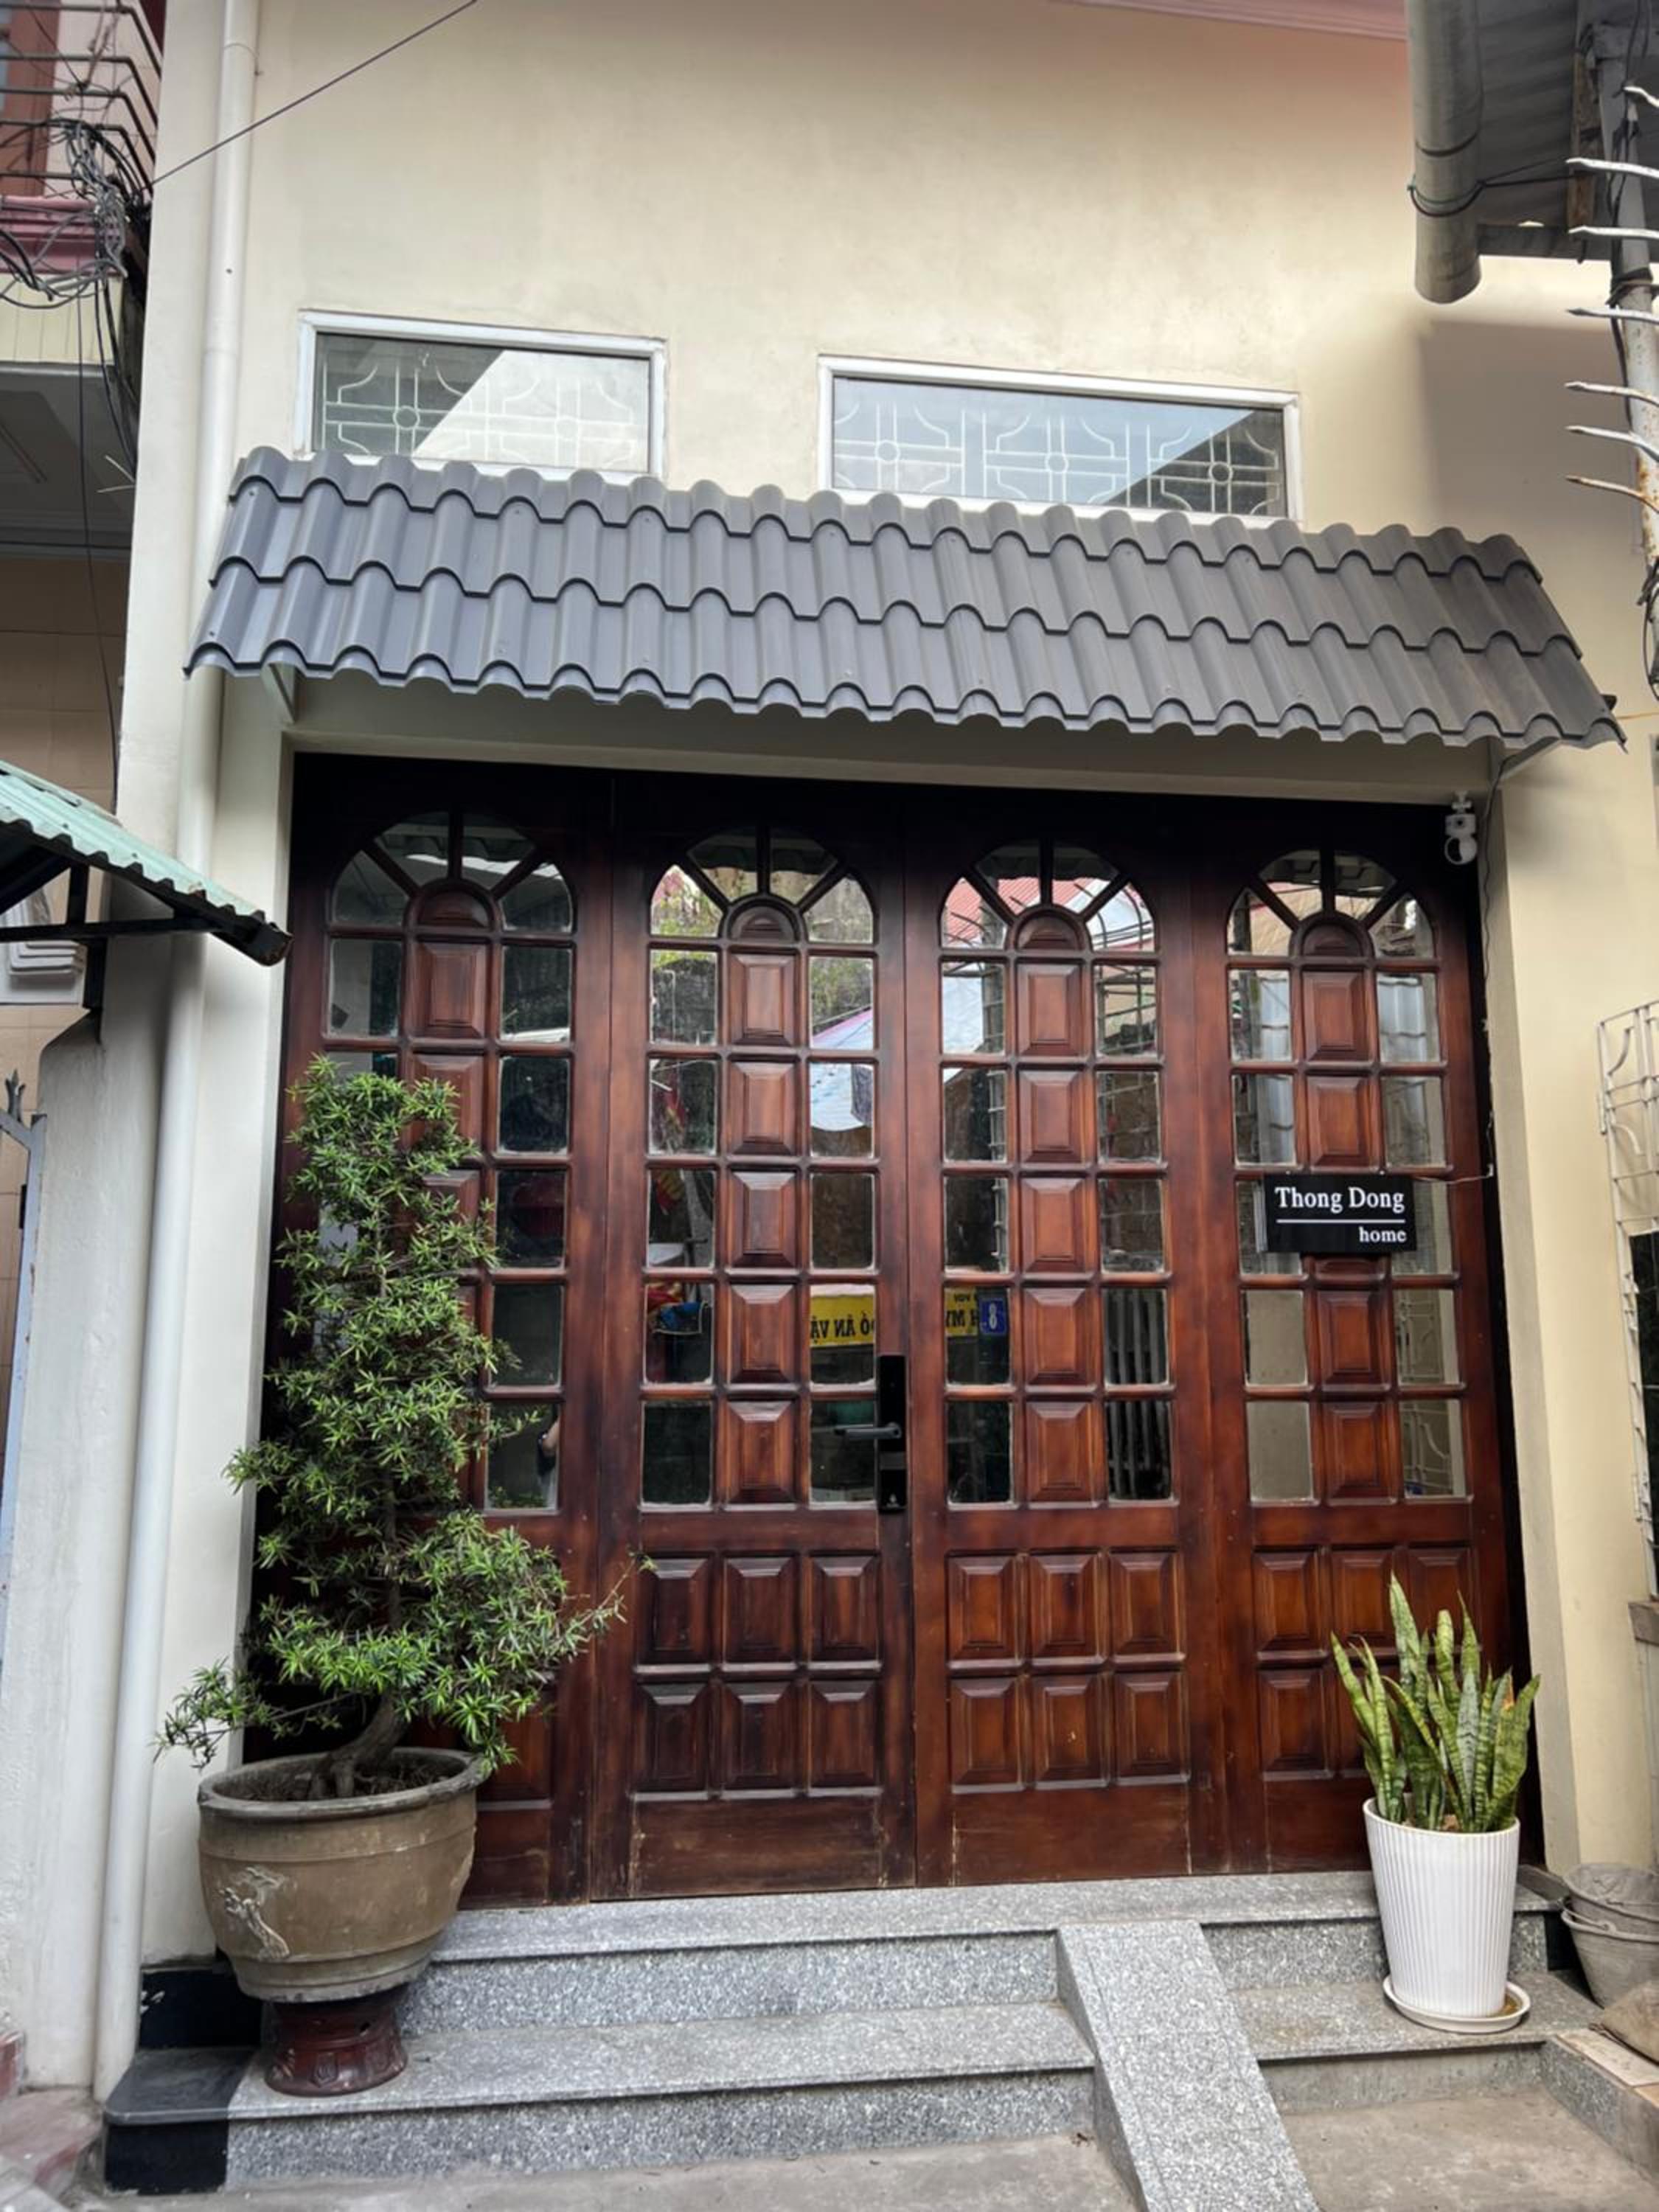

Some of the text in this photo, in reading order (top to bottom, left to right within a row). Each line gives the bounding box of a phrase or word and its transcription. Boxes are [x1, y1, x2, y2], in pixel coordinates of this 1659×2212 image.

[1275, 1186, 1405, 1214] Thong Dong
[1359, 1226, 1407, 1243] home
